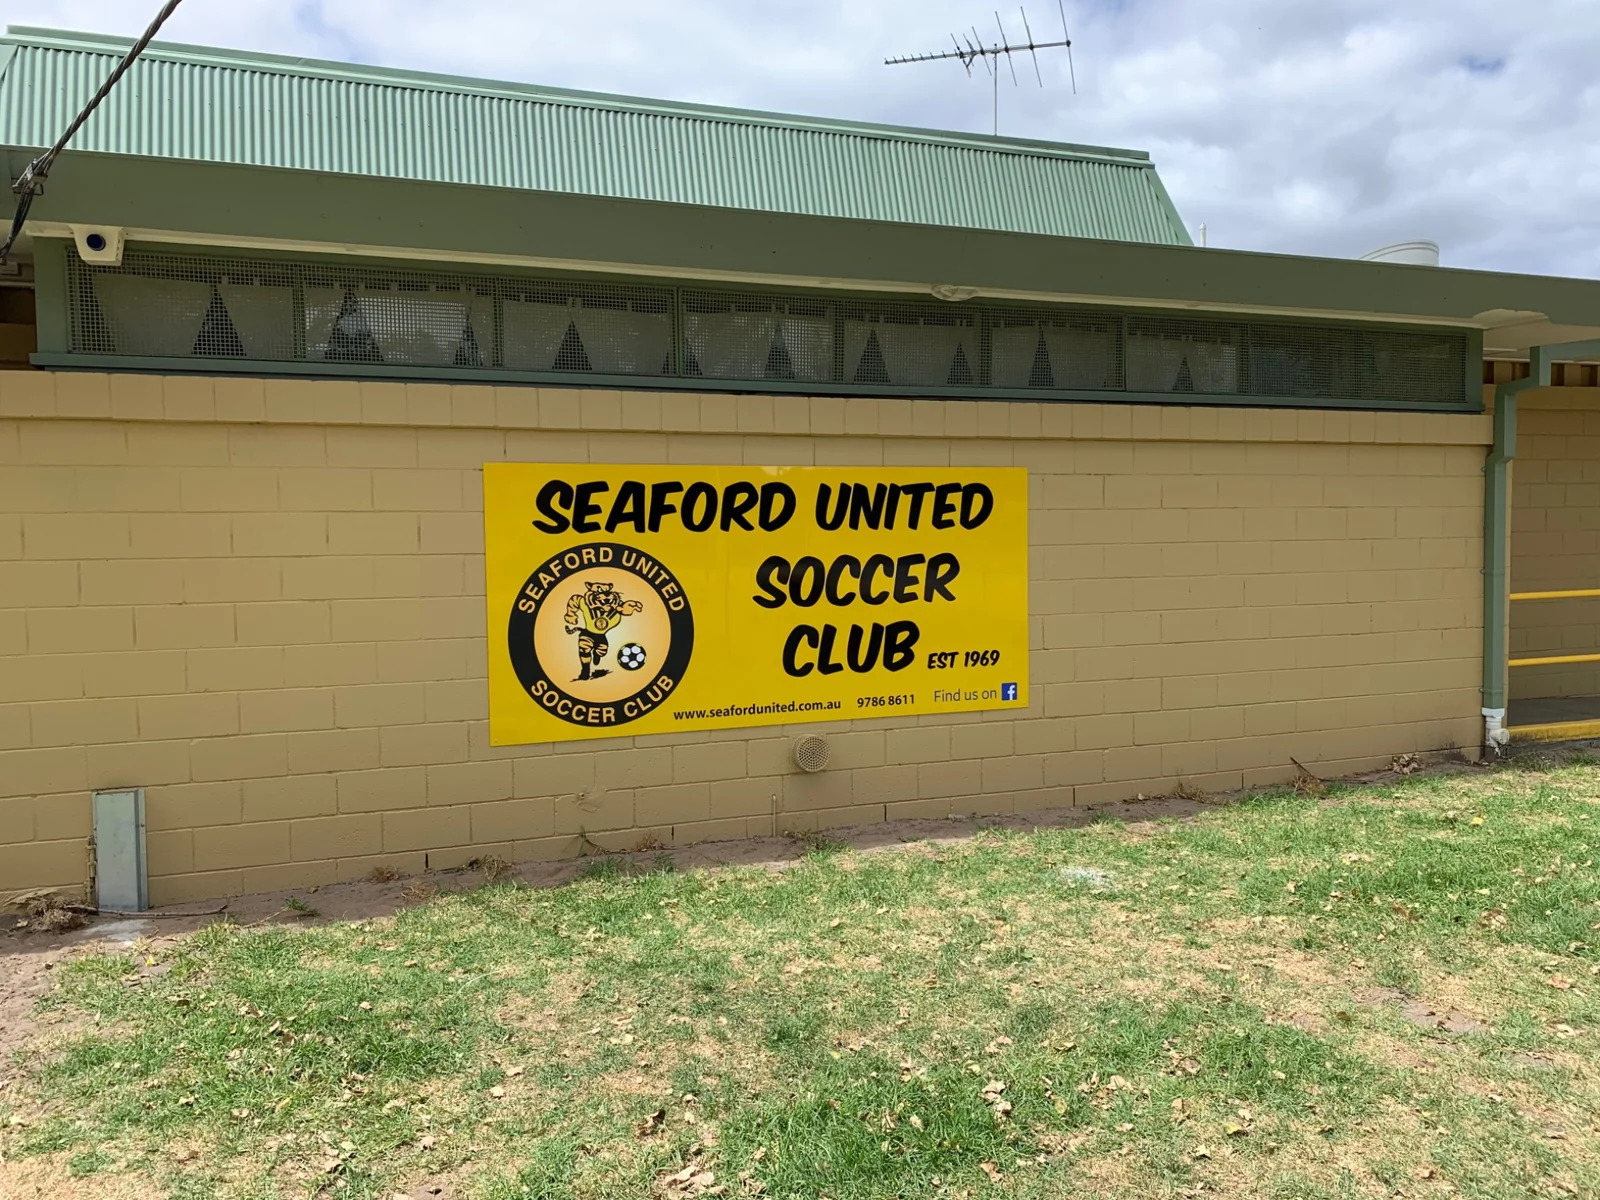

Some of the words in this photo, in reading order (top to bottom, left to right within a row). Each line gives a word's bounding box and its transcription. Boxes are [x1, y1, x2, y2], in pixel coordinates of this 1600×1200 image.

[532, 479, 797, 534] SEAFORD
[816, 481, 993, 532] UNITED
[518, 547, 613, 614] SEAFORD
[621, 550, 685, 611] UNITED
[753, 552, 960, 609] SOCCER
[782, 621, 920, 677] CLUB
[927, 651, 959, 669] EST
[964, 649, 1000, 667] 1969
[531, 679, 615, 723] SOCCER
[623, 674, 674, 718] CLUB
[673, 700, 841, 720] www.seafordunited.com.au
[857, 696, 886, 708] 9786
[888, 694, 916, 706] 8611
[934, 689, 961, 702] Find
[964, 690, 979, 701] us
[981, 689, 997, 699] on
